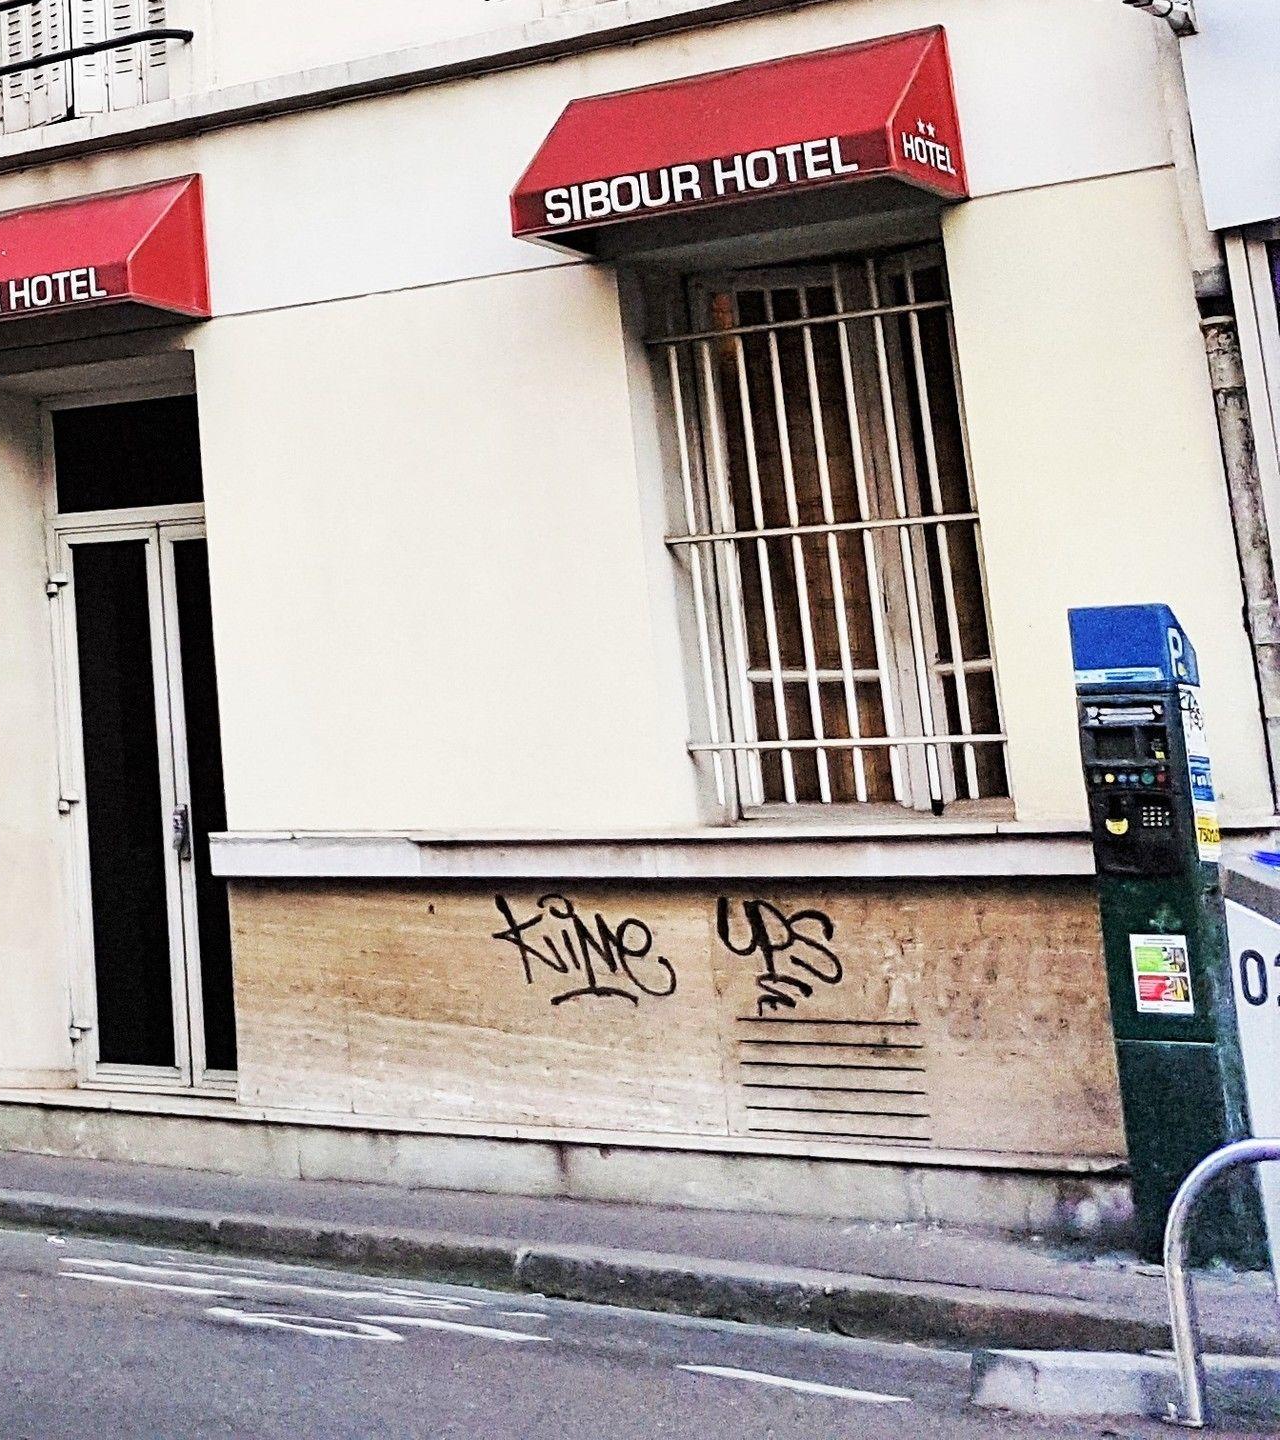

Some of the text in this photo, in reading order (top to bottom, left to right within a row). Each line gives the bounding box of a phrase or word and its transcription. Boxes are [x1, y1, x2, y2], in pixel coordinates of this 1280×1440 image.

[901, 132, 957, 176] HOTEL
[544, 138, 859, 227] SIBOUR HOTEL
[9, 267, 107, 310] HOTEL
[1240, 948, 1280, 1008] 0
